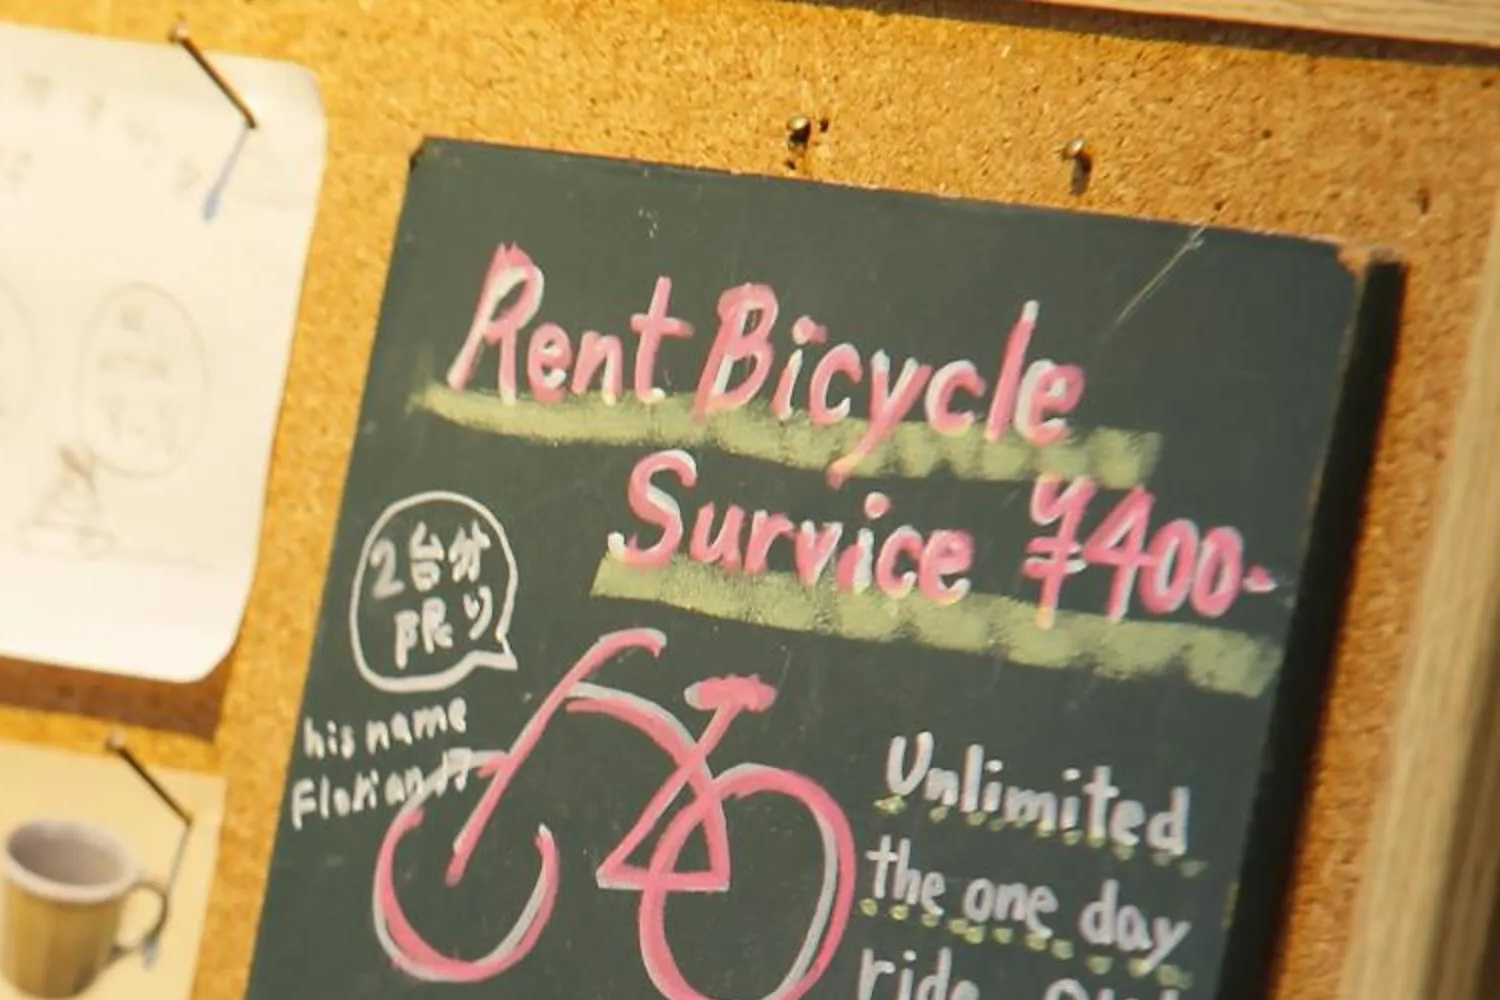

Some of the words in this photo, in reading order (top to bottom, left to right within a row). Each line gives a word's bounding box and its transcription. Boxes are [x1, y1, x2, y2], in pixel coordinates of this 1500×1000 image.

[446, 241, 694, 406] Rent
[692, 282, 1087, 488] Bicycle
[369, 519, 492, 600] 2台分
[606, 448, 974, 604] Survice
[303, 716, 356, 760] his
[364, 697, 468, 756] name
[885, 731, 1190, 857] Unlimited
[866, 834, 946, 918] the
[961, 876, 1058, 940] one
[1078, 880, 1190, 976] day
